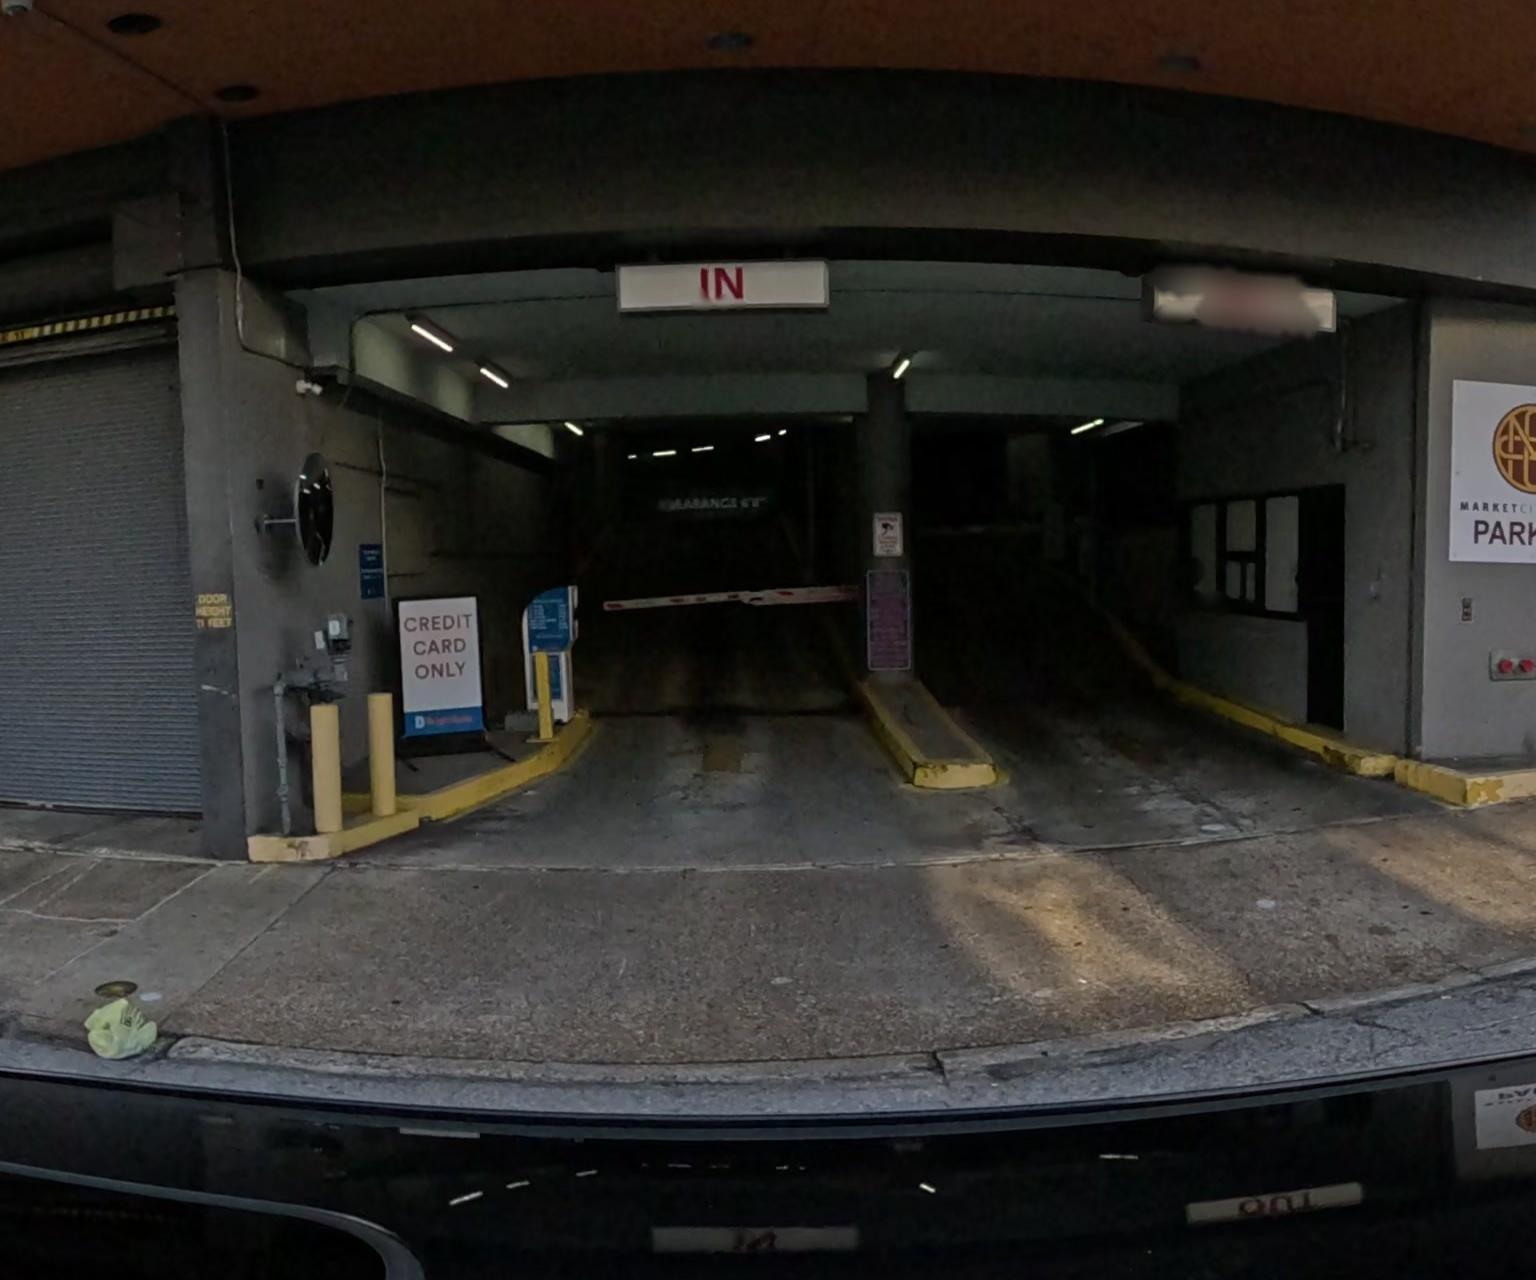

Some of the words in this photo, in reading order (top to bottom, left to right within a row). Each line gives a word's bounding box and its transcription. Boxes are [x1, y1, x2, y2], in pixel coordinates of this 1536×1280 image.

[700, 267, 744, 300] IN
[198, 593, 228, 605] DOOR
[403, 613, 473, 633] CREDIT
[413, 638, 467, 656] CARD
[414, 662, 467, 680] ONLY
